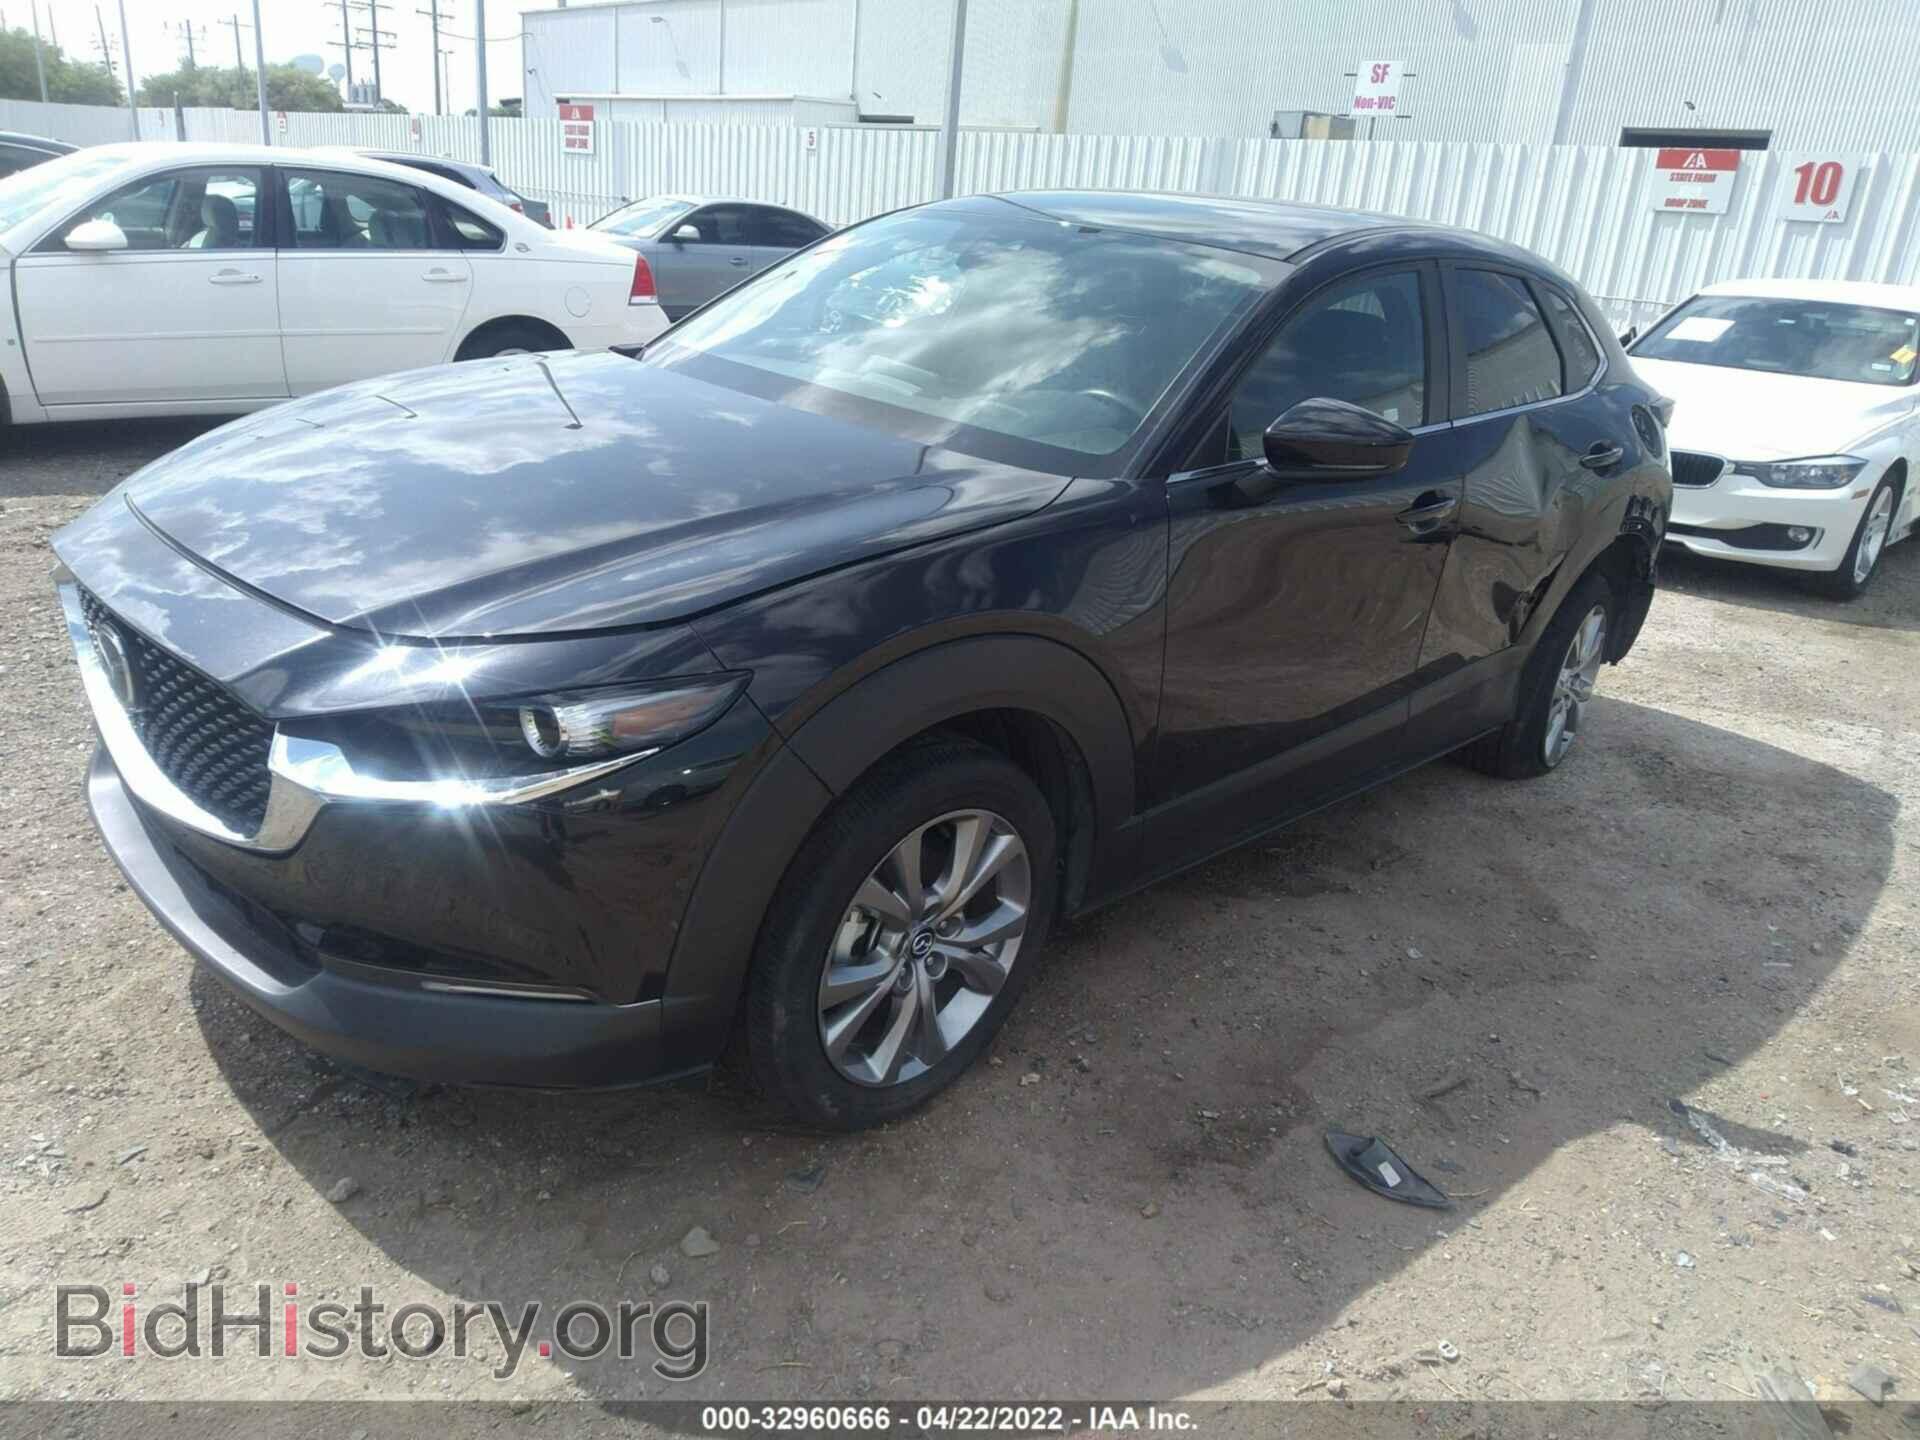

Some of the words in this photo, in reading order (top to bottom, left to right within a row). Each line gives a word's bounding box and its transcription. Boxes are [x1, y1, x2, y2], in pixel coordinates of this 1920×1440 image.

[1370, 64, 1390, 84] SF
[1353, 95, 1396, 110] Non-VIC
[1794, 161, 1843, 205] 10
